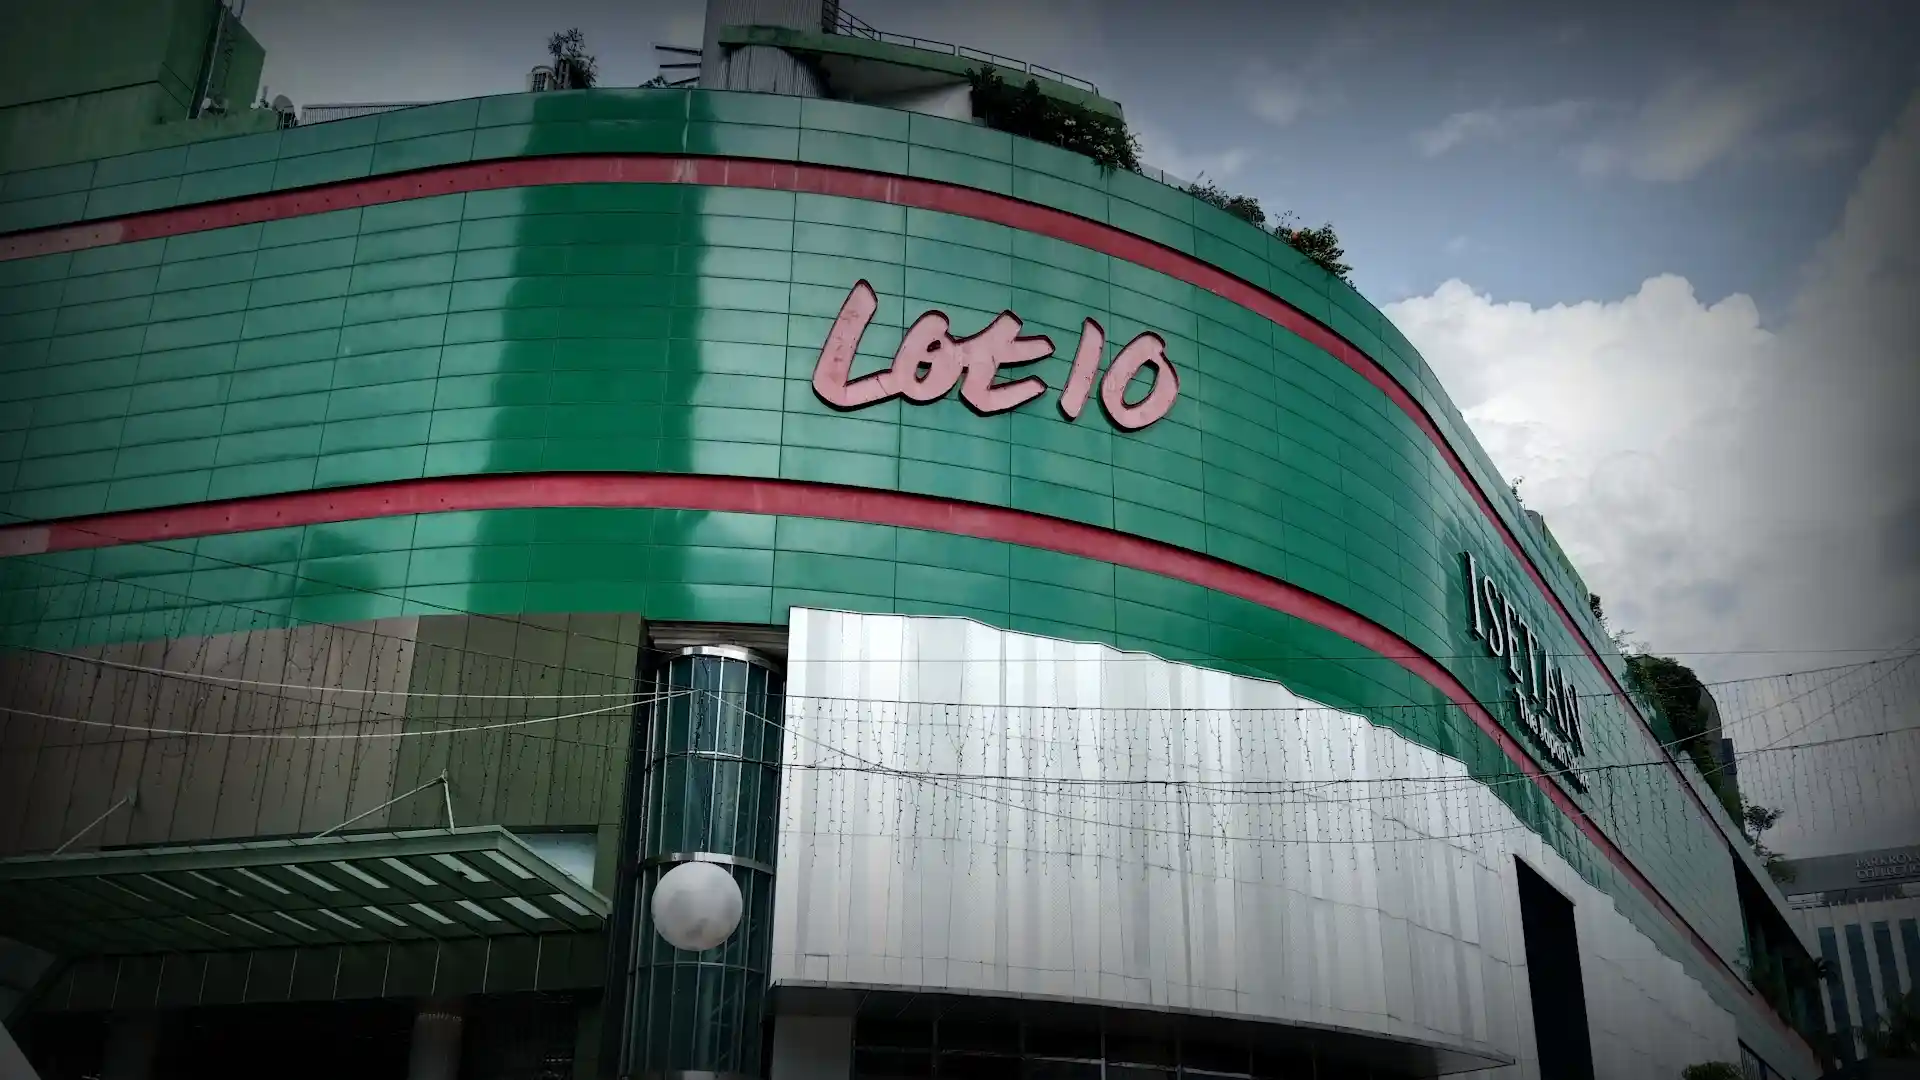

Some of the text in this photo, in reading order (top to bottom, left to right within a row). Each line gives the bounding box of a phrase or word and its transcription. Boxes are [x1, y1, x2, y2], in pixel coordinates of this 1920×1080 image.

[811, 279, 1181, 433] Lot 10
[1464, 550, 1585, 757] ISETAN
